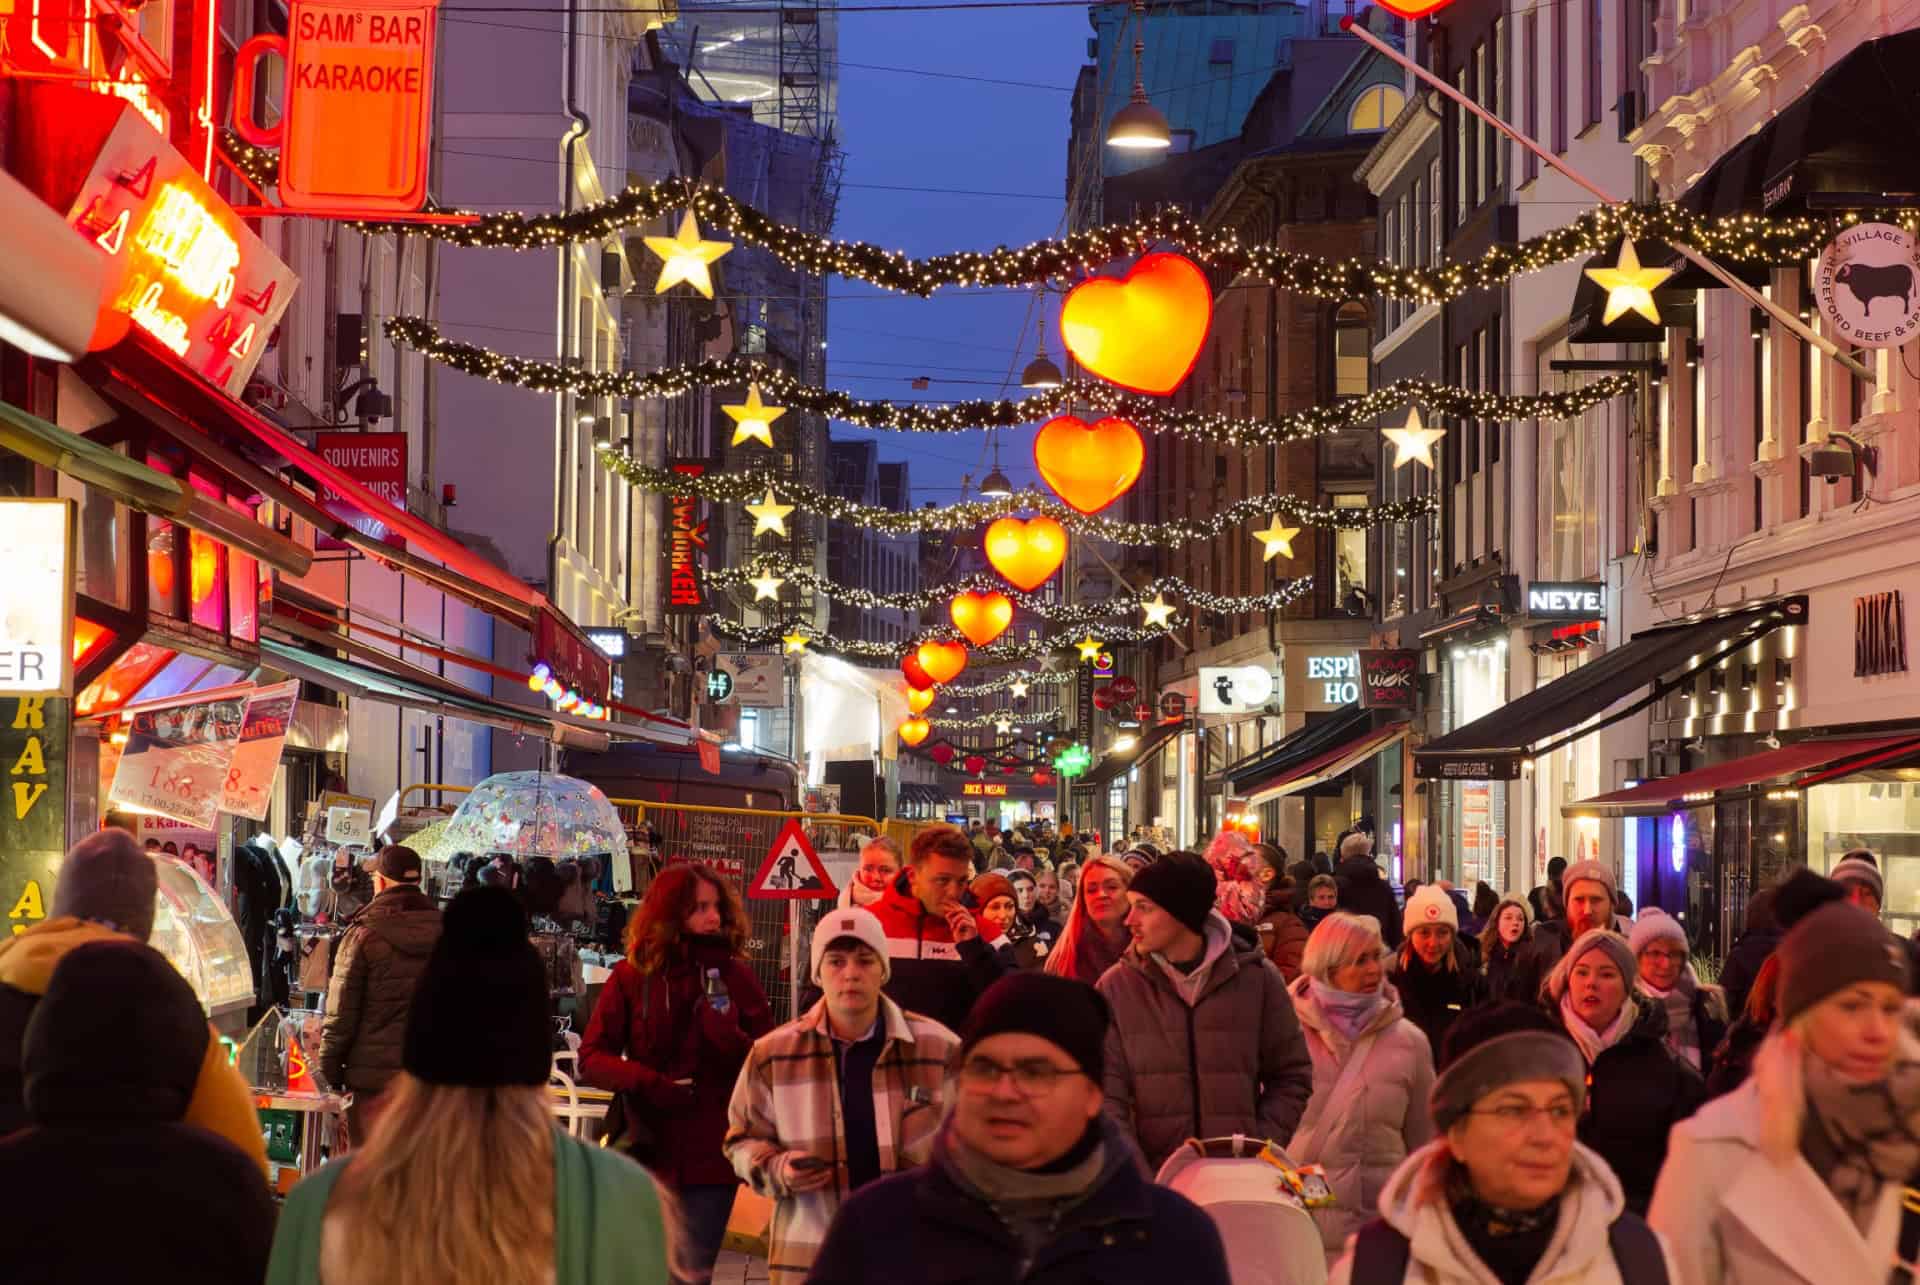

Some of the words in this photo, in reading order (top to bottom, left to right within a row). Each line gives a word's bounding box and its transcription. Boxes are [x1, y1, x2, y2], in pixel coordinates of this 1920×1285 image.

[370, 15, 421, 44] BAR
[296, 64, 419, 93] KARAOKE
[1844, 230, 1902, 246] VILLAGE
[1821, 256, 1851, 331] HEREFORD
[1855, 329, 1892, 341] BEEF
[1894, 326, 1906, 337] &
[323, 448, 399, 467] SOUVENIRS
[1529, 591, 1600, 610] NEYE
